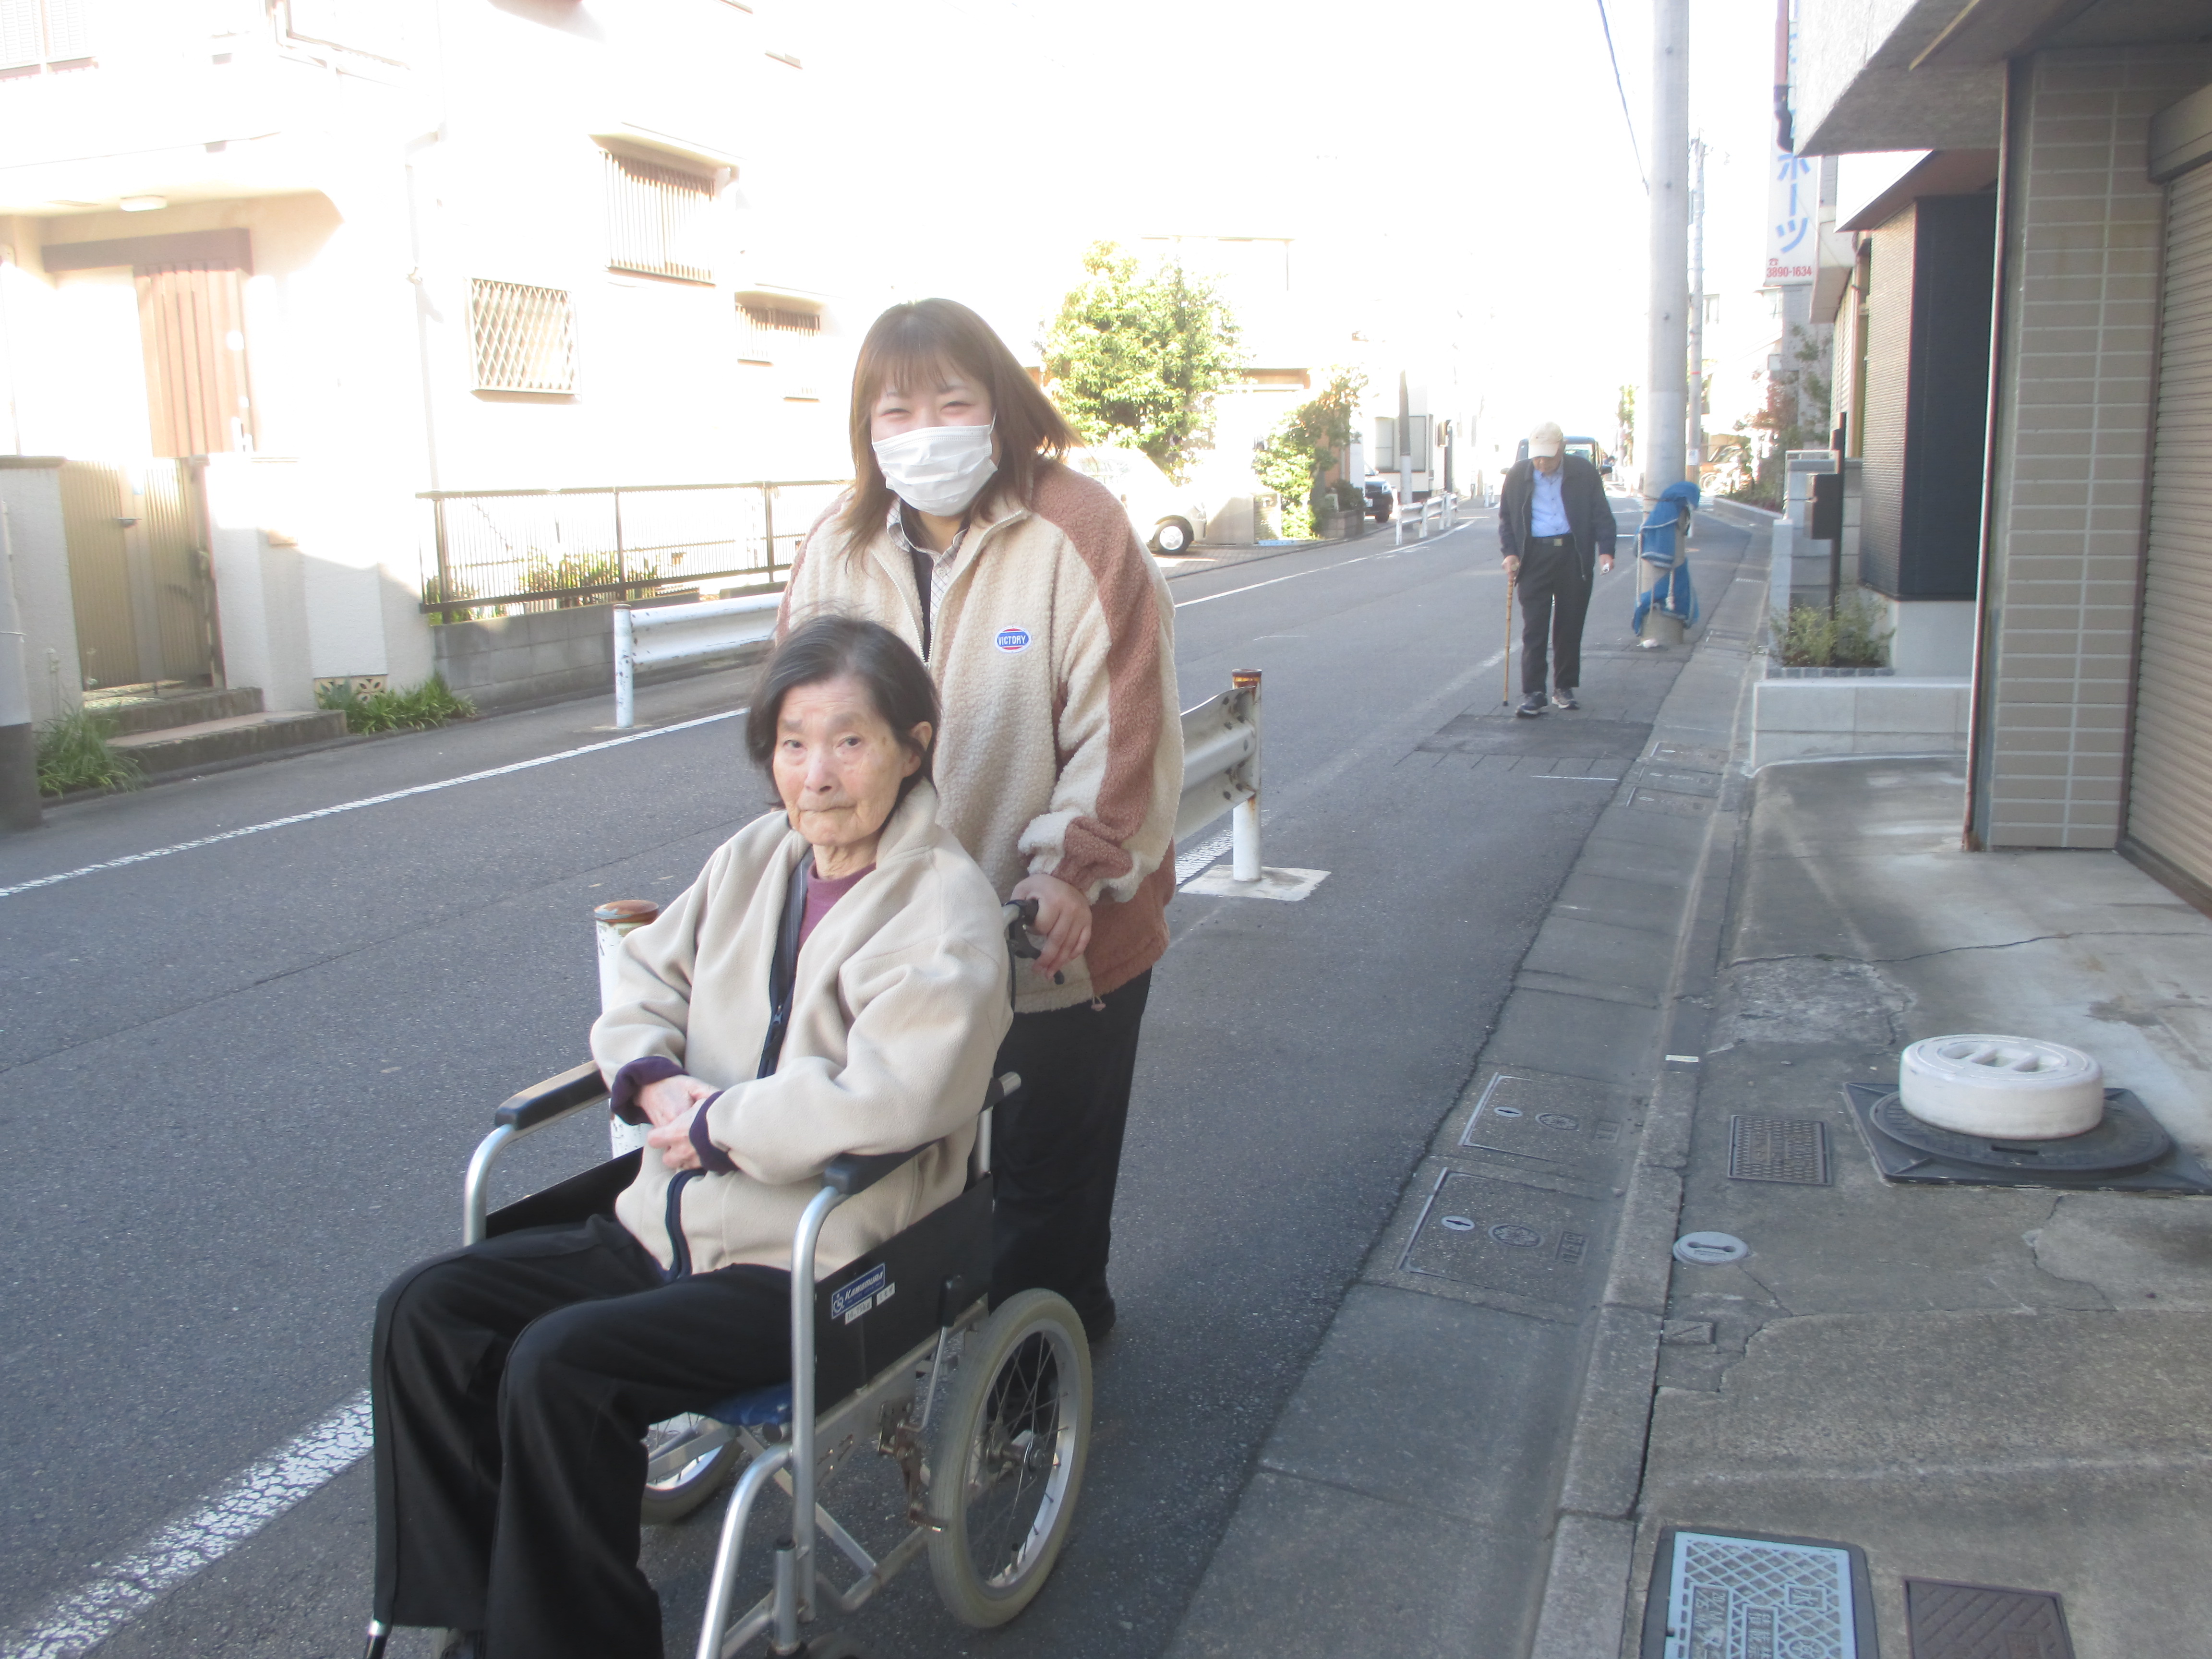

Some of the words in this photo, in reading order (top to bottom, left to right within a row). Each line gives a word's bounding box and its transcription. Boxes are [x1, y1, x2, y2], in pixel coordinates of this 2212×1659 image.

[1767, 265, 1812, 278] 3890-1634
[998, 635, 1026, 646] VICTORY
[845, 1271, 883, 1301] KAWAMURA
[1790, 1588, 1818, 1607] 水
